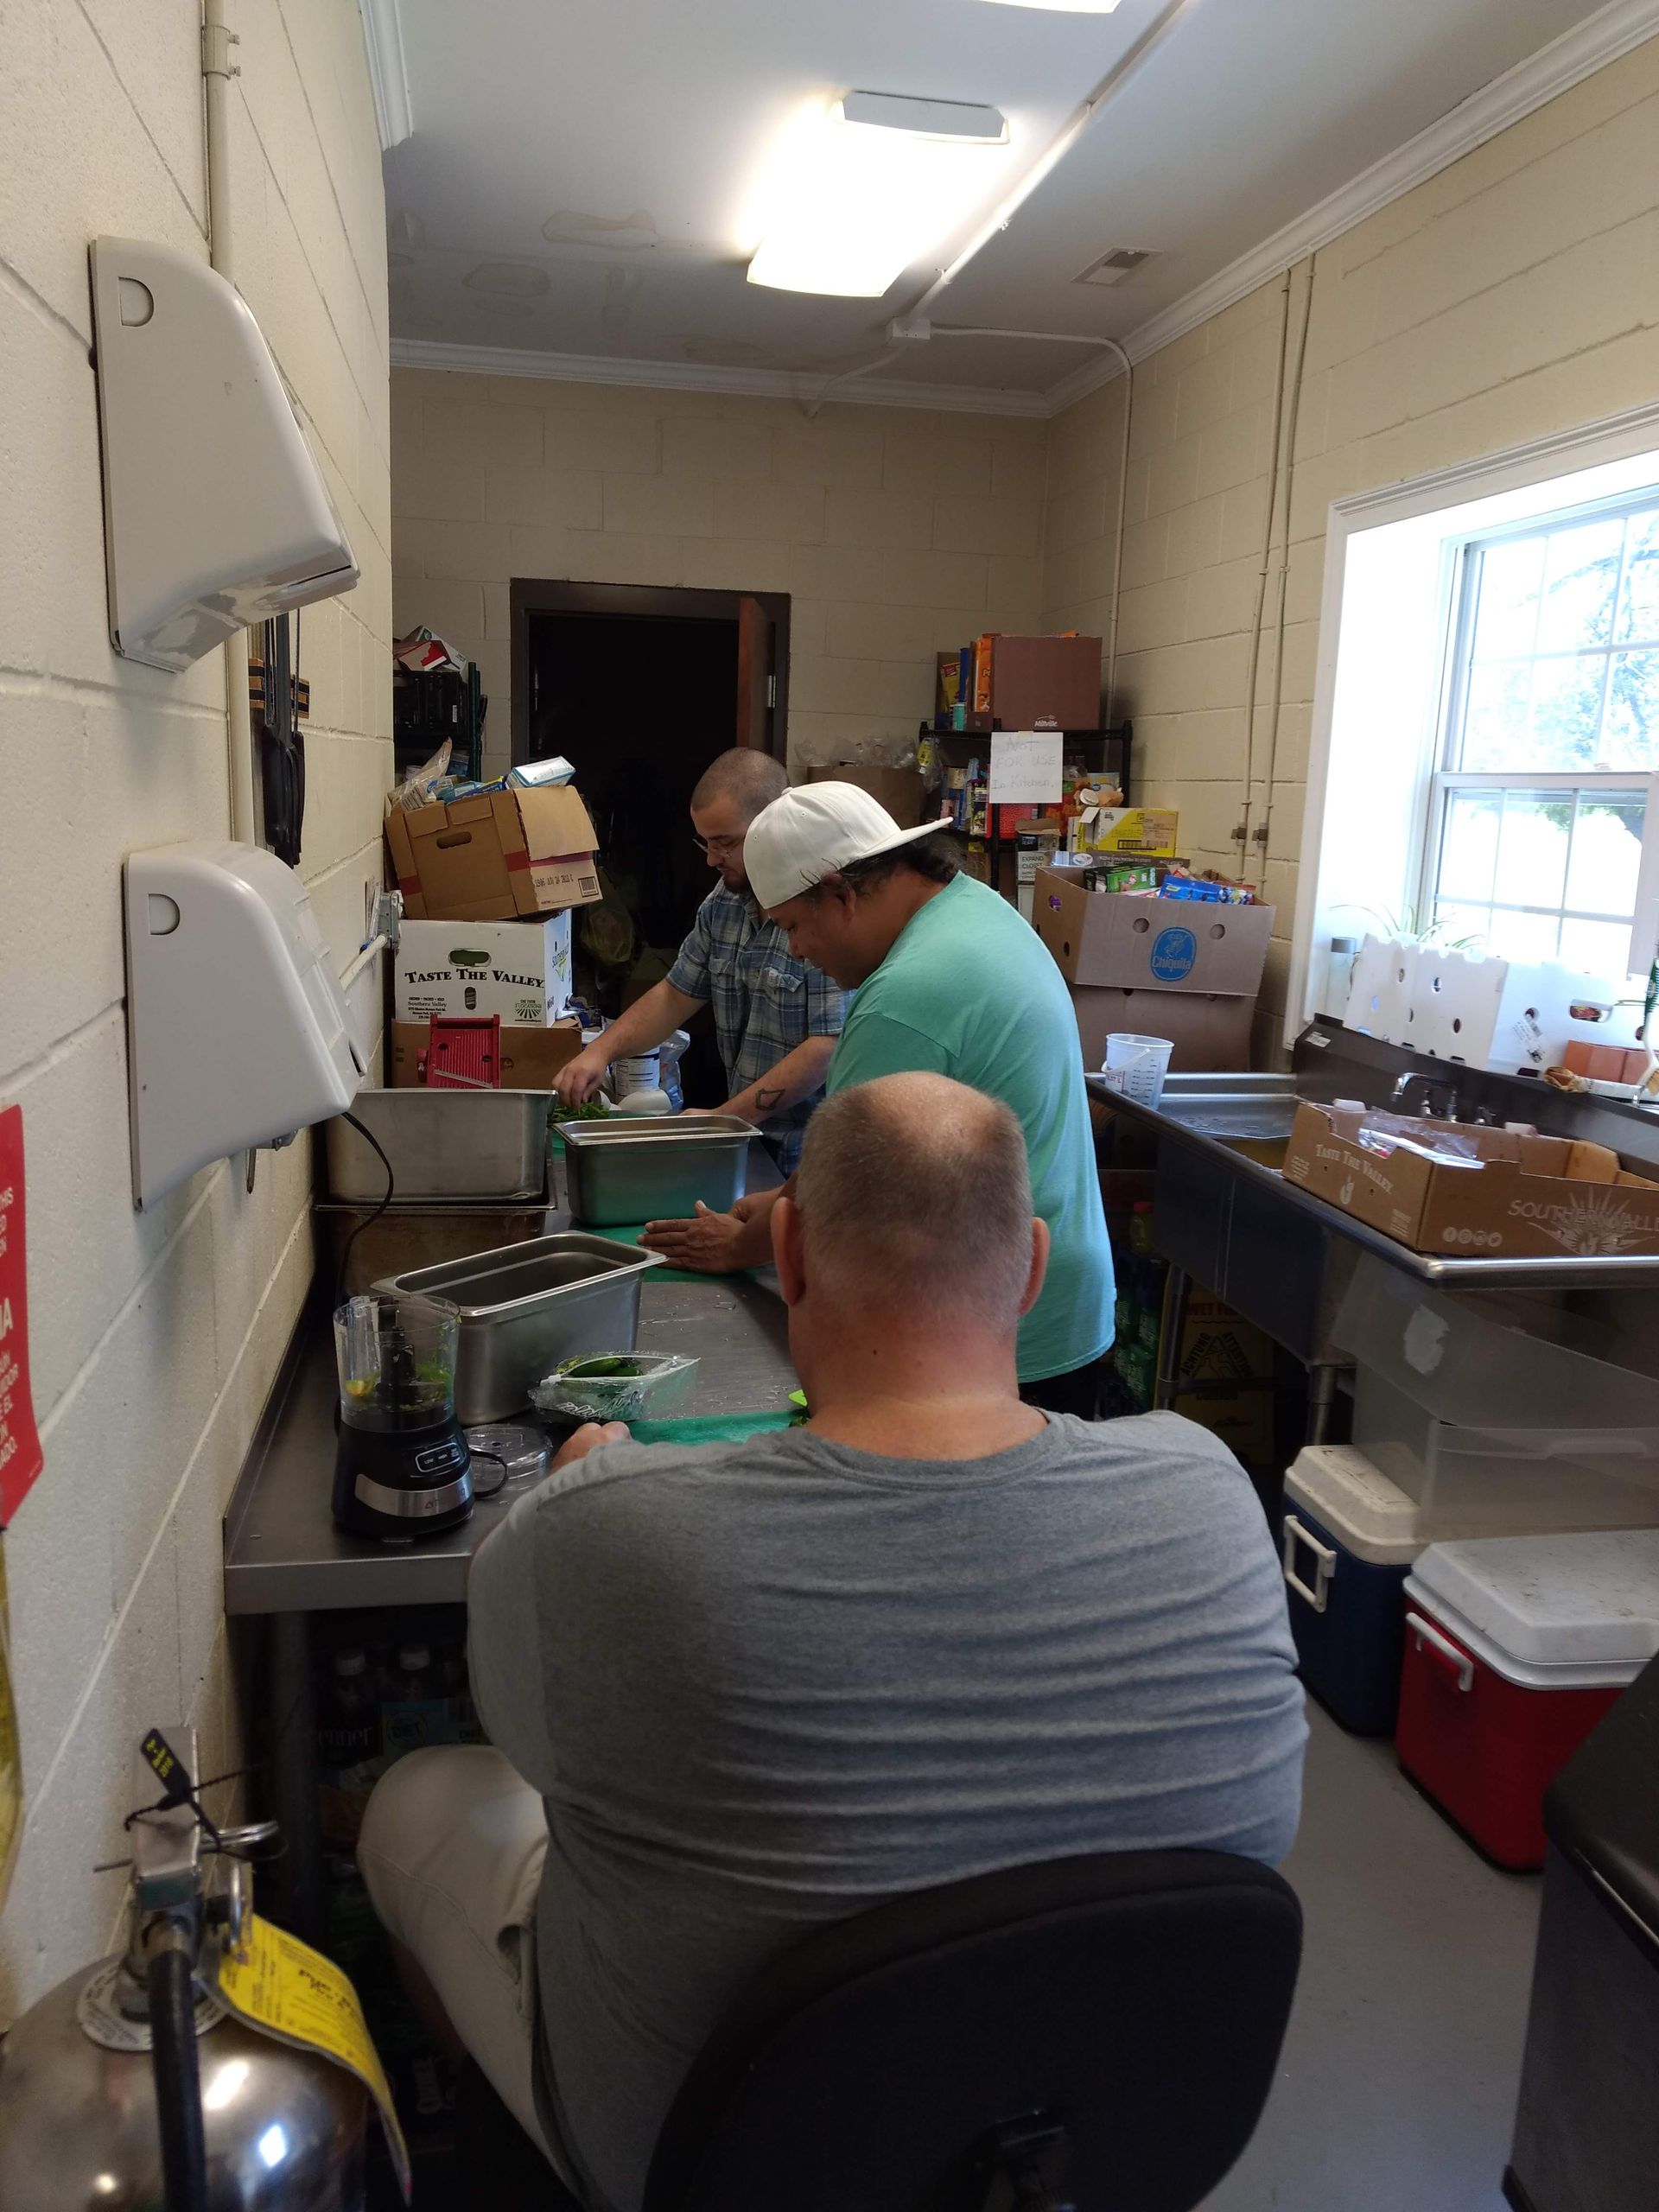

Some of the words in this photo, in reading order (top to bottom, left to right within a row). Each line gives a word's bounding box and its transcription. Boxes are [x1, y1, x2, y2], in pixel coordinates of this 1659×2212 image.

[995, 755, 1023, 768] FOR
[1032, 753, 1057, 766] USE
[1152, 956, 1192, 972] Chiquita
[404, 971, 452, 983] TASTE
[456, 969, 487, 981] THE
[492, 969, 545, 988] VALLEY
[1315, 1144, 1342, 1161] TASTE
[1343, 1150, 1362, 1171] THE
[1362, 1160, 1395, 1195] VALLEY
[1508, 1199, 1606, 1225] SOUTHERN
[1180, 1332, 1211, 1376] ACHTUNG
